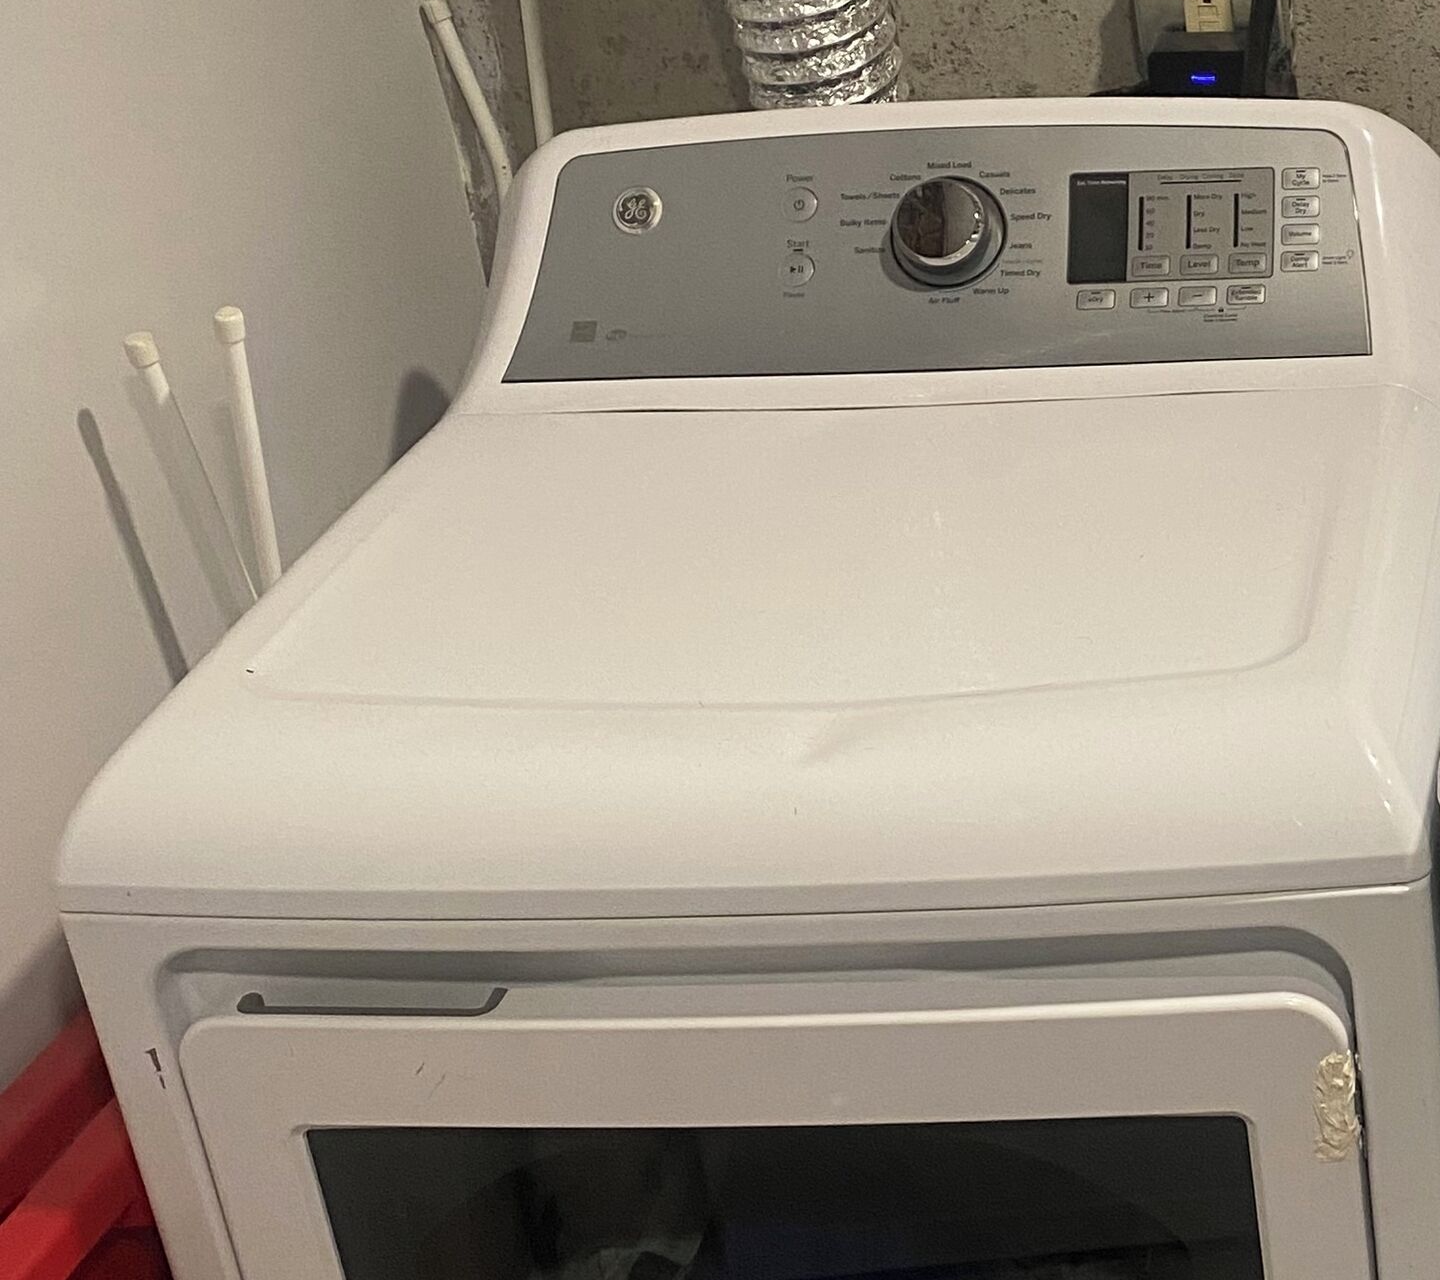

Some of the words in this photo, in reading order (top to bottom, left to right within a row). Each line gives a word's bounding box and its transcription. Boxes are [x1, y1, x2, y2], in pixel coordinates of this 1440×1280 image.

[927, 161, 951, 169] Mixed
[786, 174, 814, 183] Power
[889, 173, 921, 181] Cottons
[979, 170, 1010, 178] Casuals
[1000, 187, 1036, 195] Delicates
[1009, 213, 1035, 222] Speed
[1037, 212, 1052, 221] Dry
[787, 239, 810, 249] Start
[1187, 260, 1211, 269] Level
[1236, 258, 1260, 267] Temp
[1027, 269, 1041, 278] Dry
